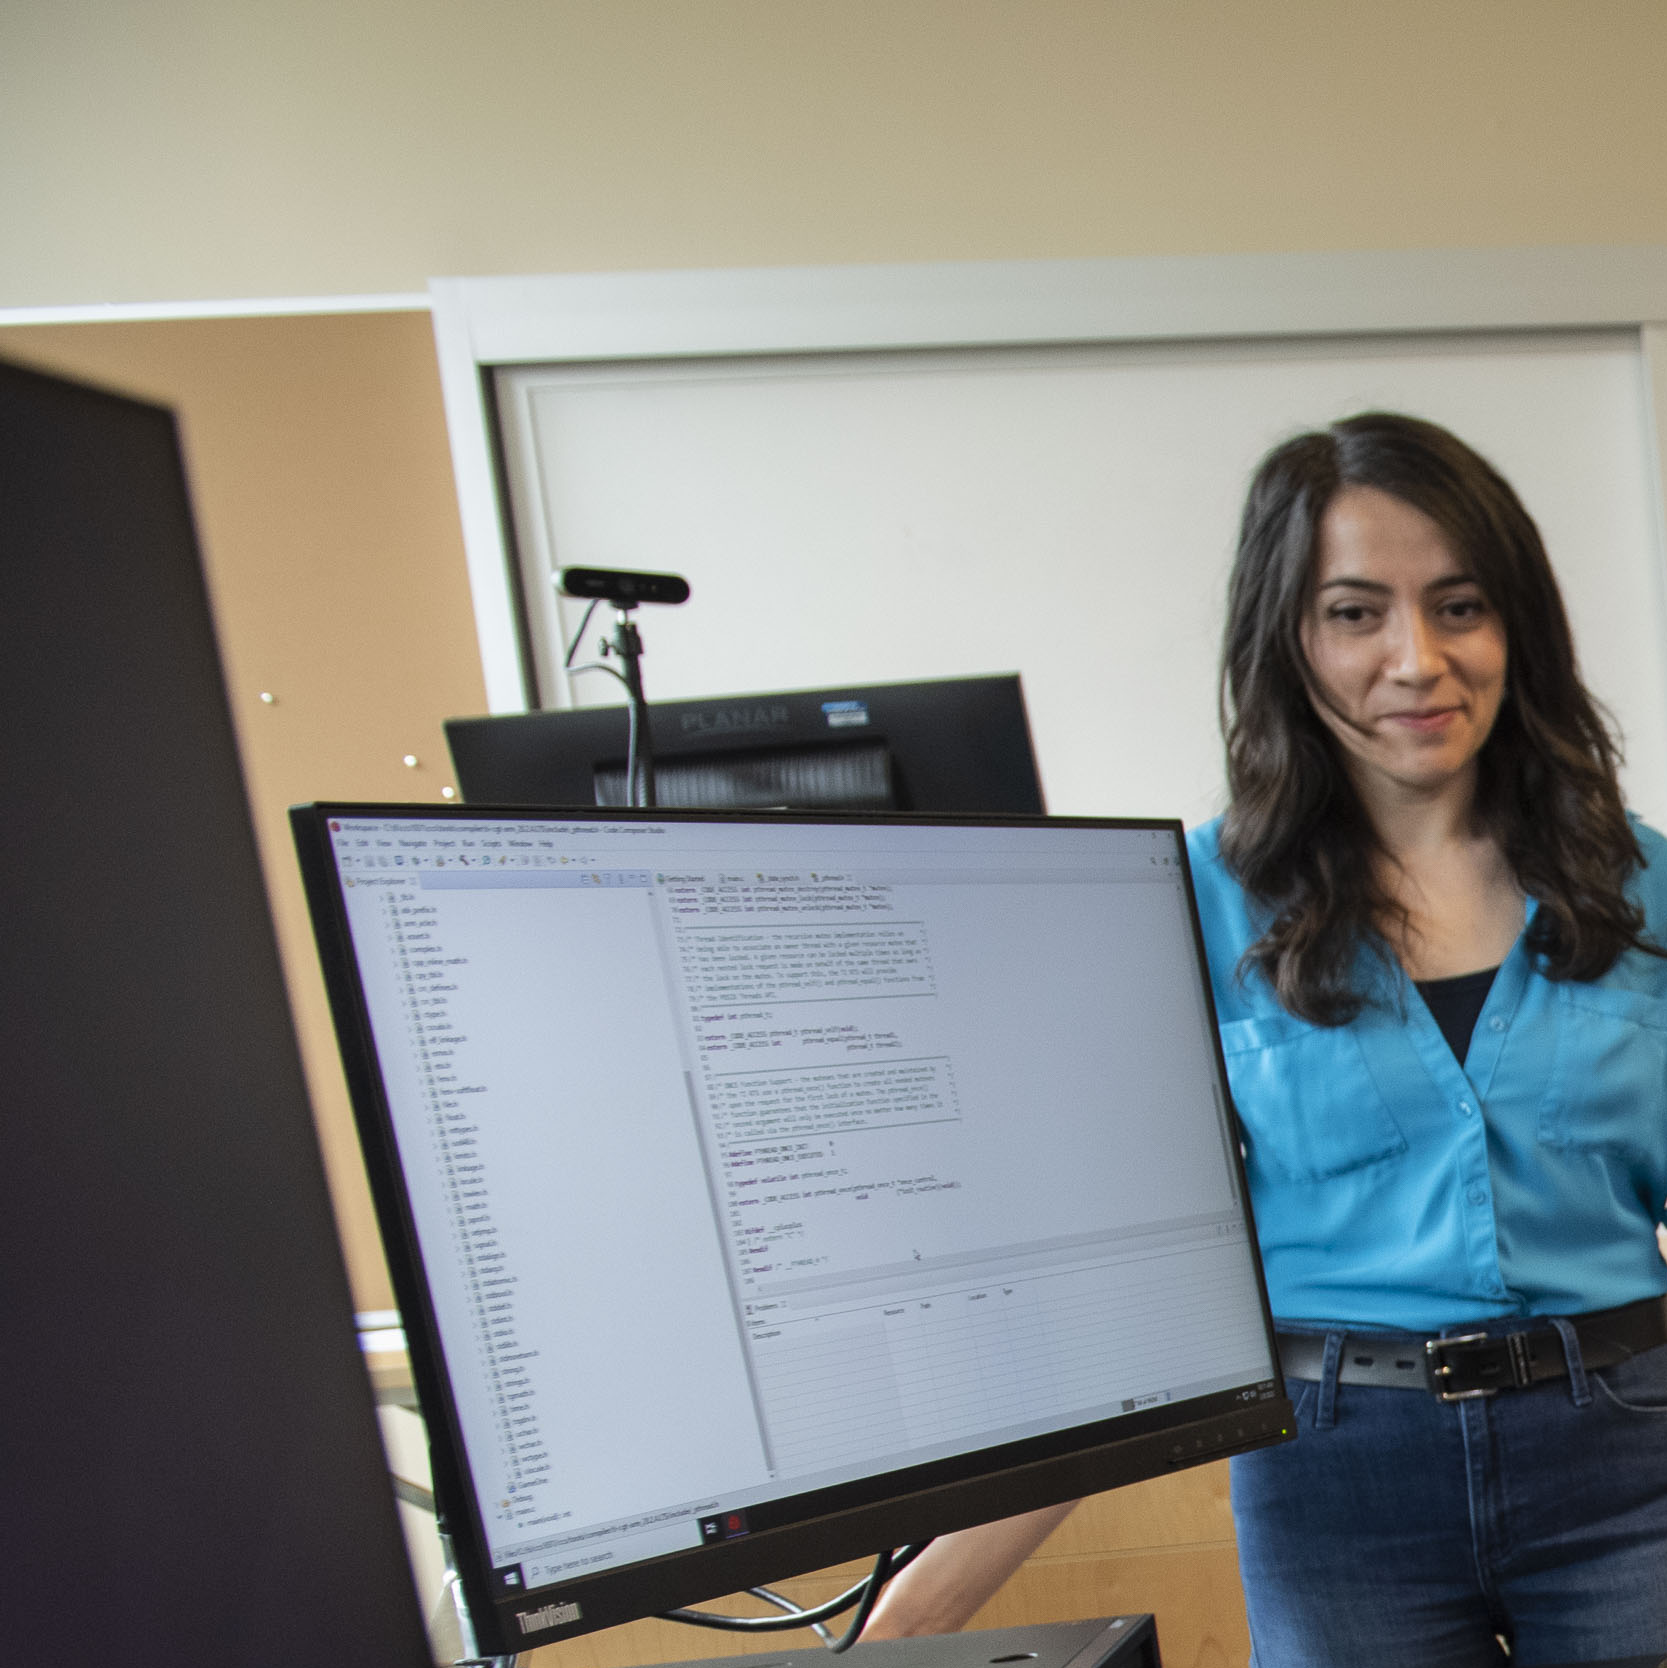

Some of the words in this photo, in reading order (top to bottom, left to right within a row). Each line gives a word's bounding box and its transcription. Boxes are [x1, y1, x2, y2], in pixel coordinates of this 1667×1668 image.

[681, 704, 791, 731] PLANAR
[433, 840, 456, 848] Project
[545, 1564, 563, 1576] Type
[563, 1559, 581, 1570] here
[581, 1557, 589, 1567] to
[590, 1551, 614, 1564] search
[514, 1601, 583, 1635] ThinkVision
